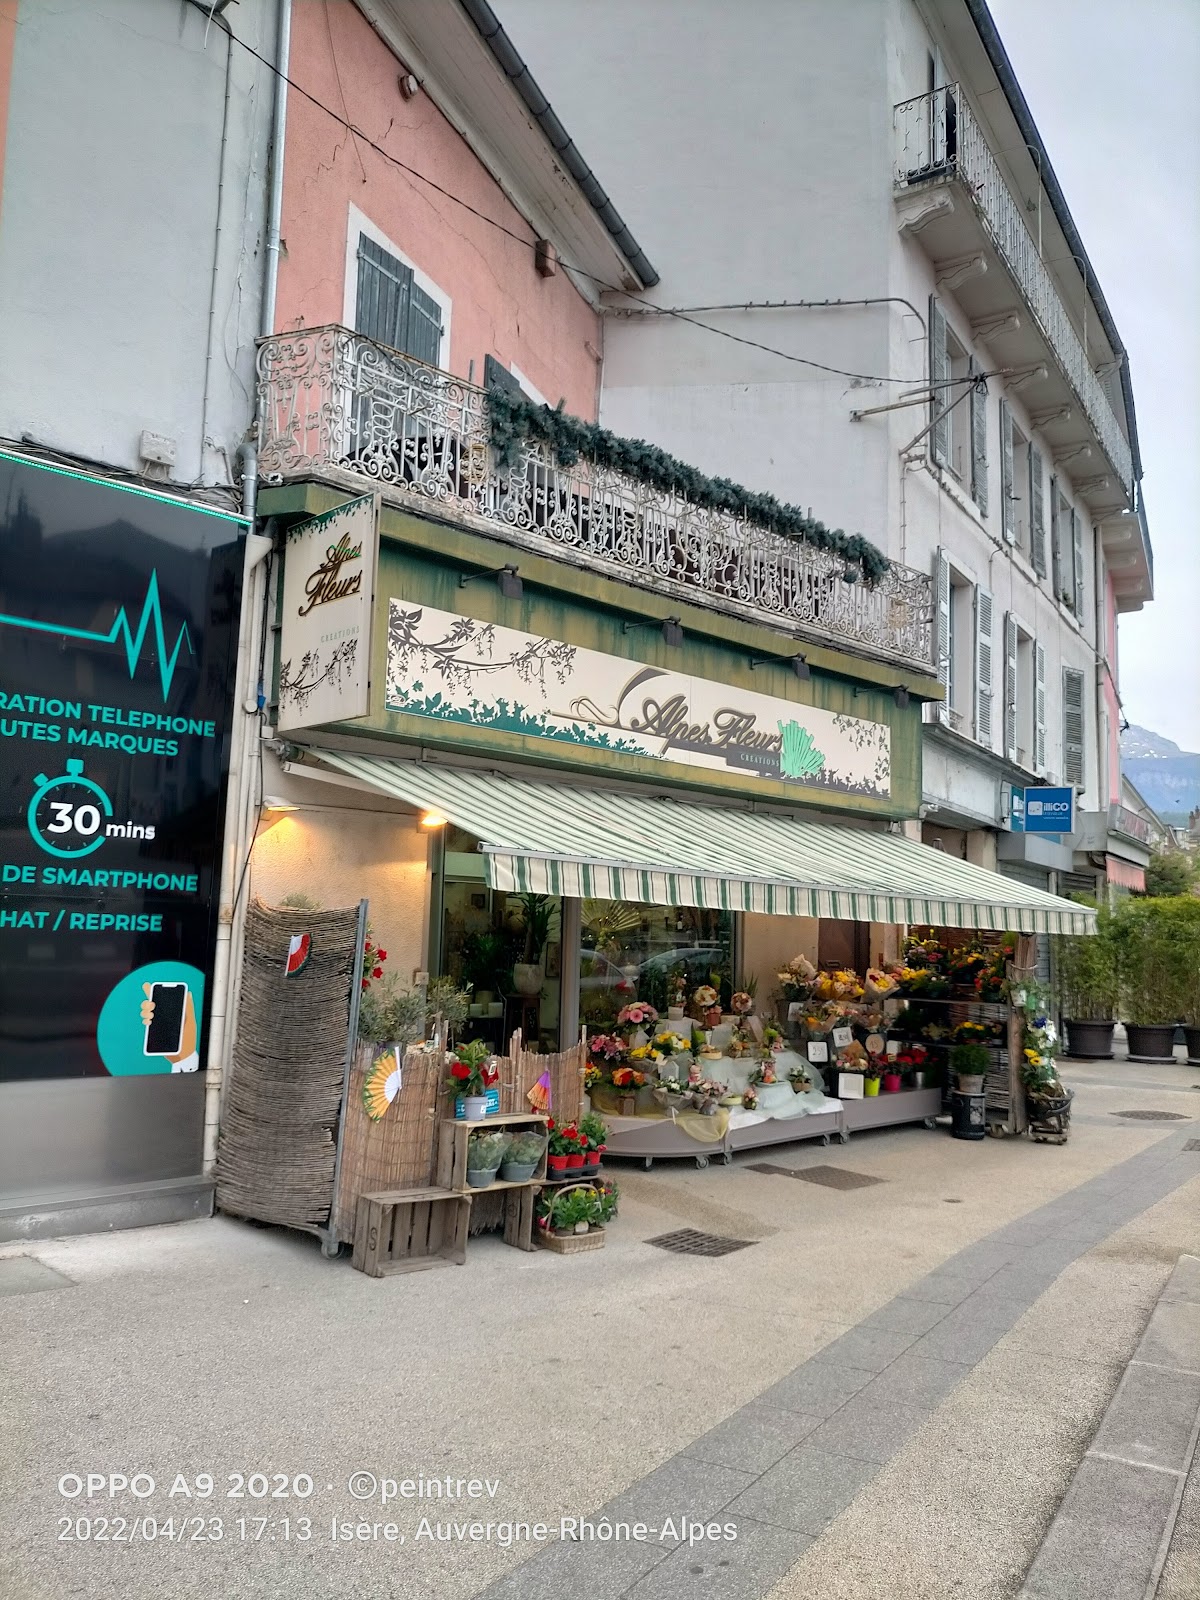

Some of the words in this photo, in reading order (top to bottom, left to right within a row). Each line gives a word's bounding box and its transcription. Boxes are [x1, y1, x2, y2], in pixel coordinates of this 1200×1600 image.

[298, 567, 362, 617] Fleurs
[320, 626, 360, 643] CREATIONS
[0, 719, 61, 742] UTES
[67, 727, 179, 757] MARQUES
[87, 704, 216, 738] TELEPHONE
[630, 693, 712, 755] Alpes
[713, 707, 783, 751] Fleurs
[740, 753, 780, 768] CREATIONS
[47, 802, 101, 835] 30
[105, 821, 155, 840] mins
[2, 864, 37, 883] DE
[42, 867, 199, 892] SMARTPHONE
[0, 910, 50, 929] HAT
[69, 912, 163, 932] REPRISE
